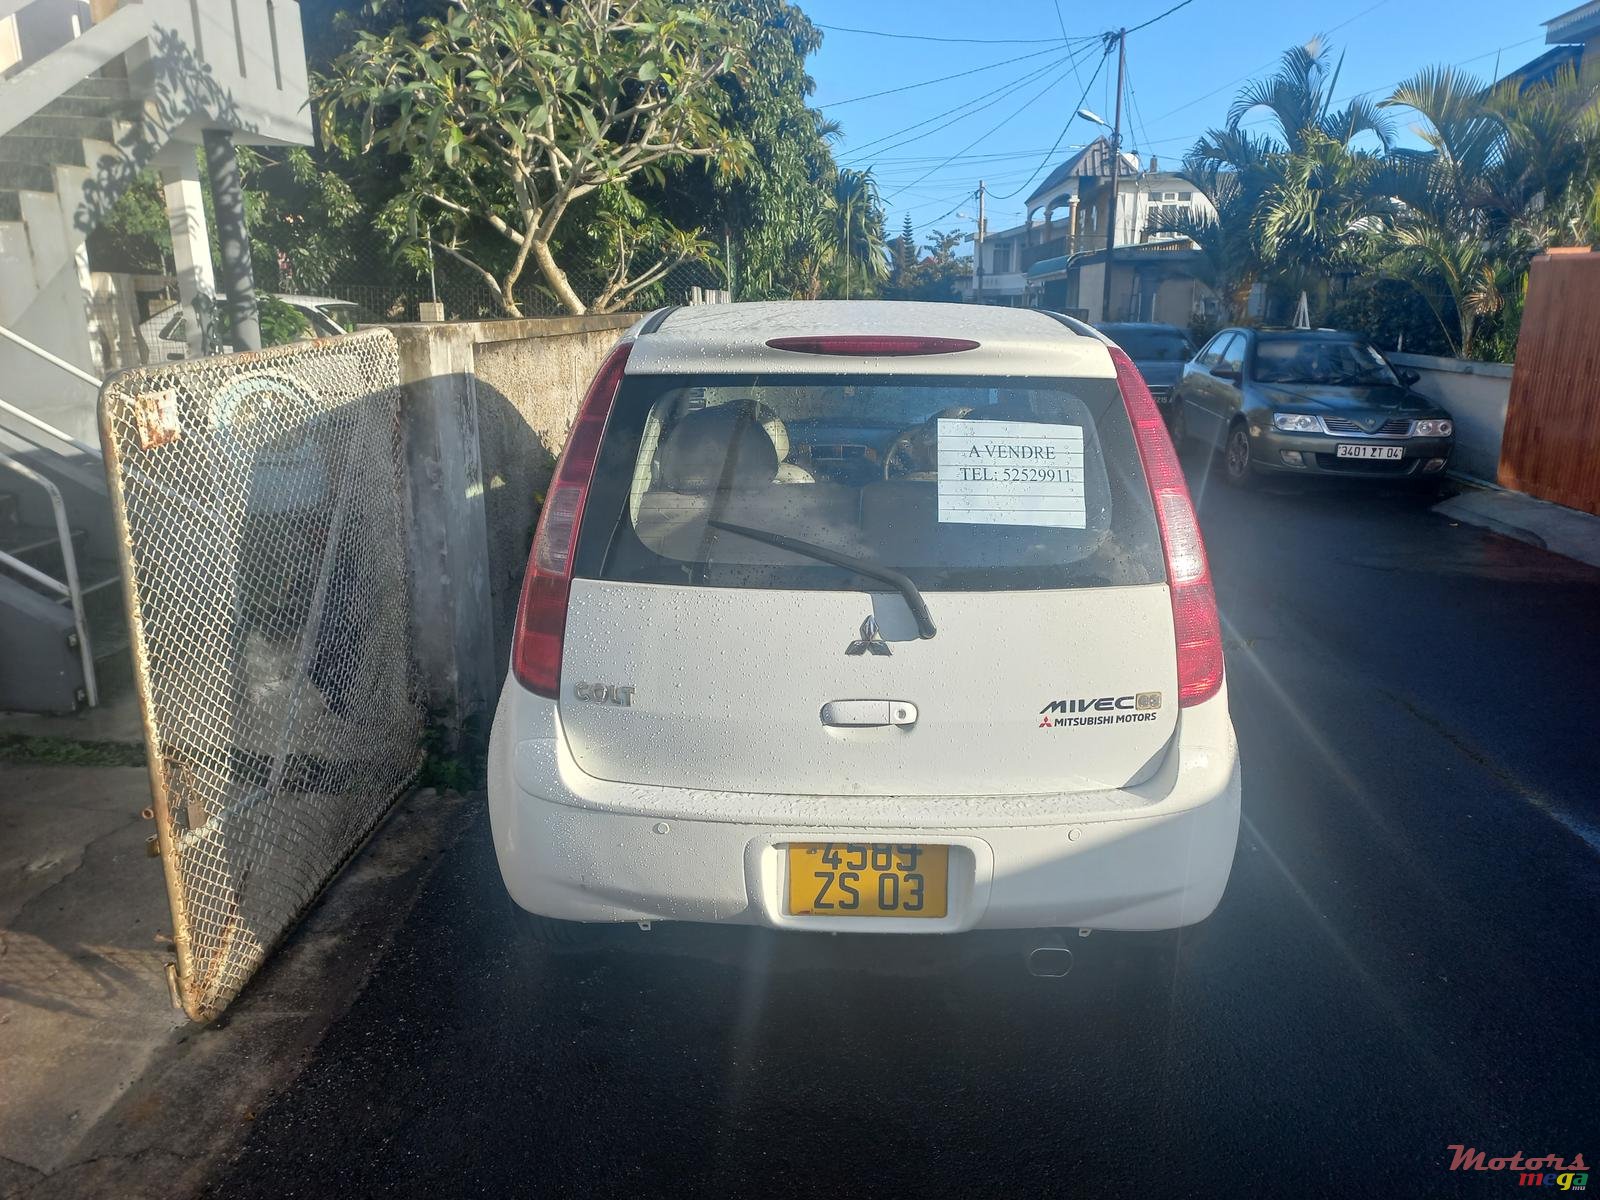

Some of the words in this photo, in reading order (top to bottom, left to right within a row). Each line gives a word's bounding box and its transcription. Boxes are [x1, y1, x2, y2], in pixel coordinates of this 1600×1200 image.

[968, 446, 981, 458] A
[985, 445, 1056, 460] VENDRE
[1341, 446, 1367, 456] 3401
[960, 468, 999, 481] TEL:
[1003, 468, 1071, 483] 52529911
[575, 681, 635, 707] COLT
[1040, 696, 1135, 714] MIVEC
[1054, 716, 1113, 727] MITSUBISHI
[1116, 712, 1157, 724] MOTORS
[813, 871, 860, 910] ZS
[878, 873, 924, 911] 03
